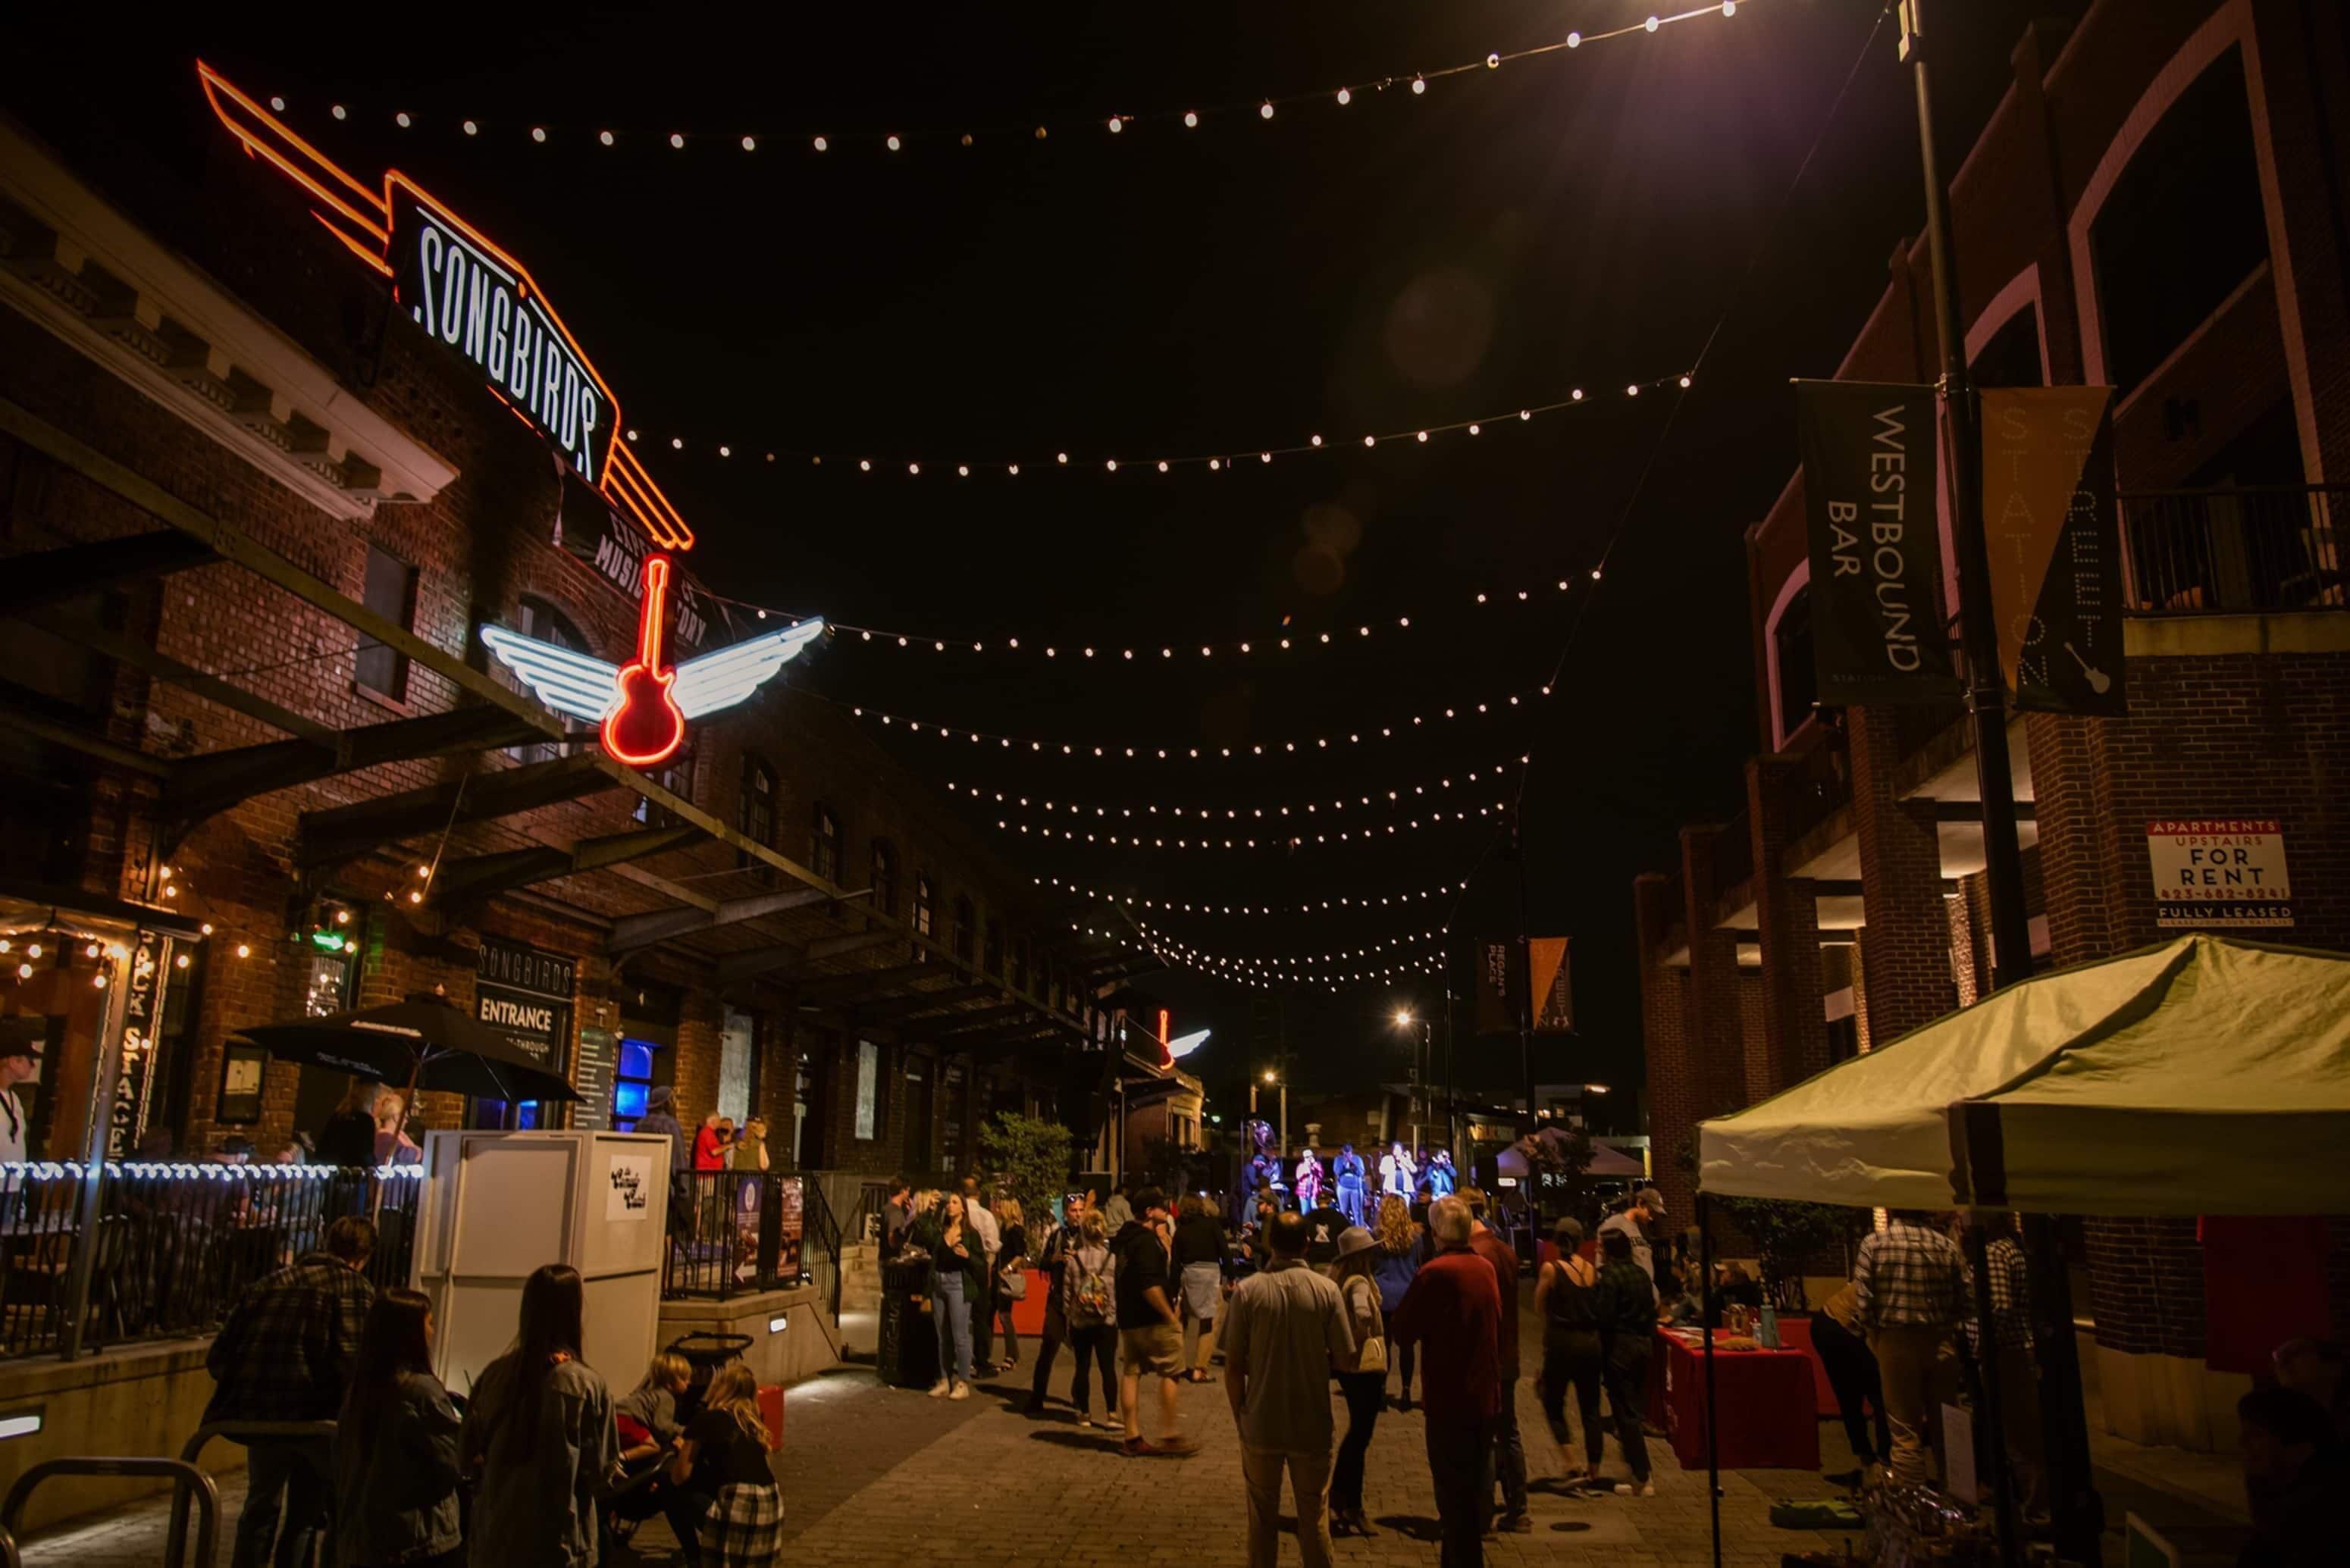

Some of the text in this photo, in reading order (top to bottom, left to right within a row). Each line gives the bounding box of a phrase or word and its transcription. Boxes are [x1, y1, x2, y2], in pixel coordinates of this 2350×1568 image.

[414, 225, 597, 482] SONGBIRDS
[1827, 500, 1861, 577] BAR
[1870, 404, 1921, 672] WESTBOUND
[2001, 405, 2050, 687] STATION
[2062, 407, 2102, 648] STREET
[2152, 821, 2276, 833] APARTMENTS
[2176, 836, 2263, 847] UPSTAIRS
[2180, 868, 2264, 886] RENT
[2190, 848, 2248, 865] FOR
[2159, 906, 2292, 918] FULLY LEASED
[478, 944, 572, 995] SONGBIRDS
[480, 997, 553, 1031] ENTRANCE
